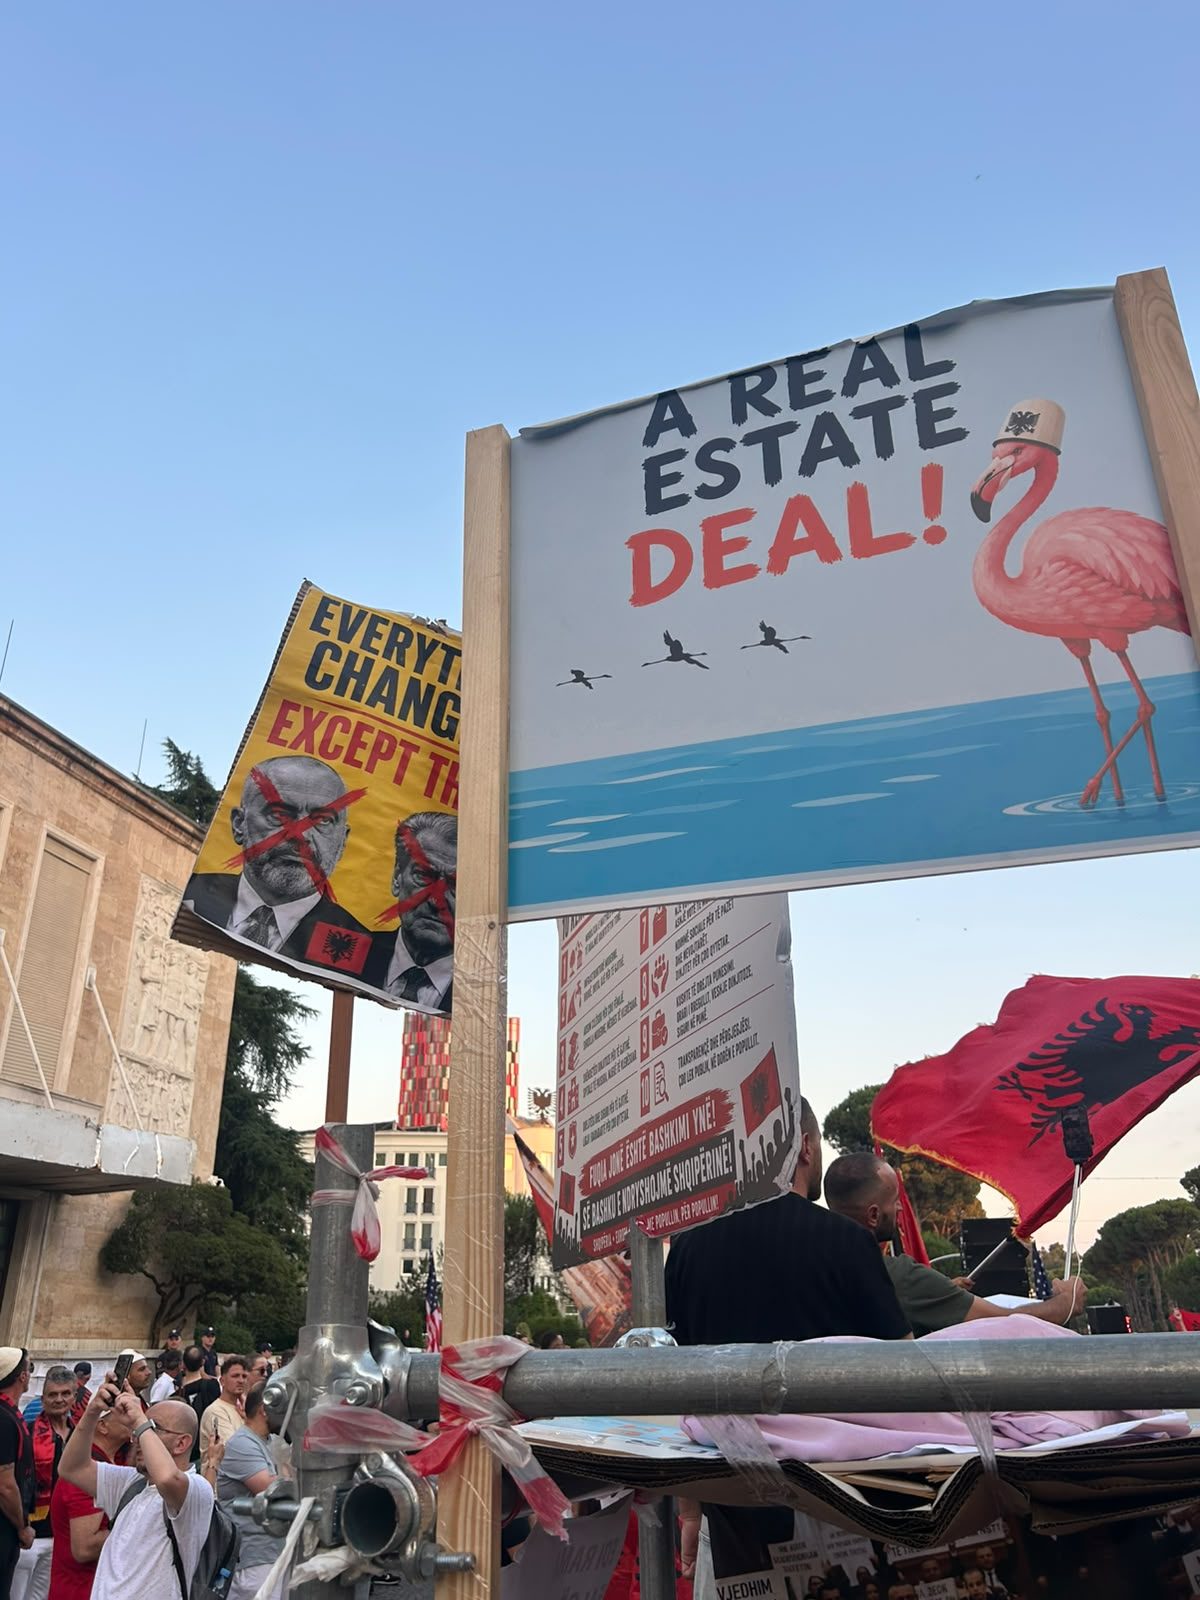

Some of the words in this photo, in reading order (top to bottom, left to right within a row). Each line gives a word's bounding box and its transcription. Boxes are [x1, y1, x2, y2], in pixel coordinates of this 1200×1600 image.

[642, 389, 697, 447] A
[727, 323, 956, 426] REAL
[642, 381, 970, 515] ESTATE
[625, 462, 947, 607] DEAL!
[304, 640, 461, 745] CHANG
[267, 699, 420, 786] EXCEPT
[641, 1073, 649, 1110] 10
[582, 1200, 591, 1231] SË
[592, 1193, 616, 1228] BASHKU
[616, 1192, 622, 1217] E
[622, 1161, 674, 1214] NDRYSHOJMË
[673, 1138, 733, 1193] SHQIPËRINË!
[589, 1159, 608, 1189] FUQIA
[608, 1143, 624, 1179] JONË
[625, 1130, 647, 1169] ËSHTË
[649, 1112, 690, 1157] BASHKIMI
[692, 1095, 716, 1136] YNË!
